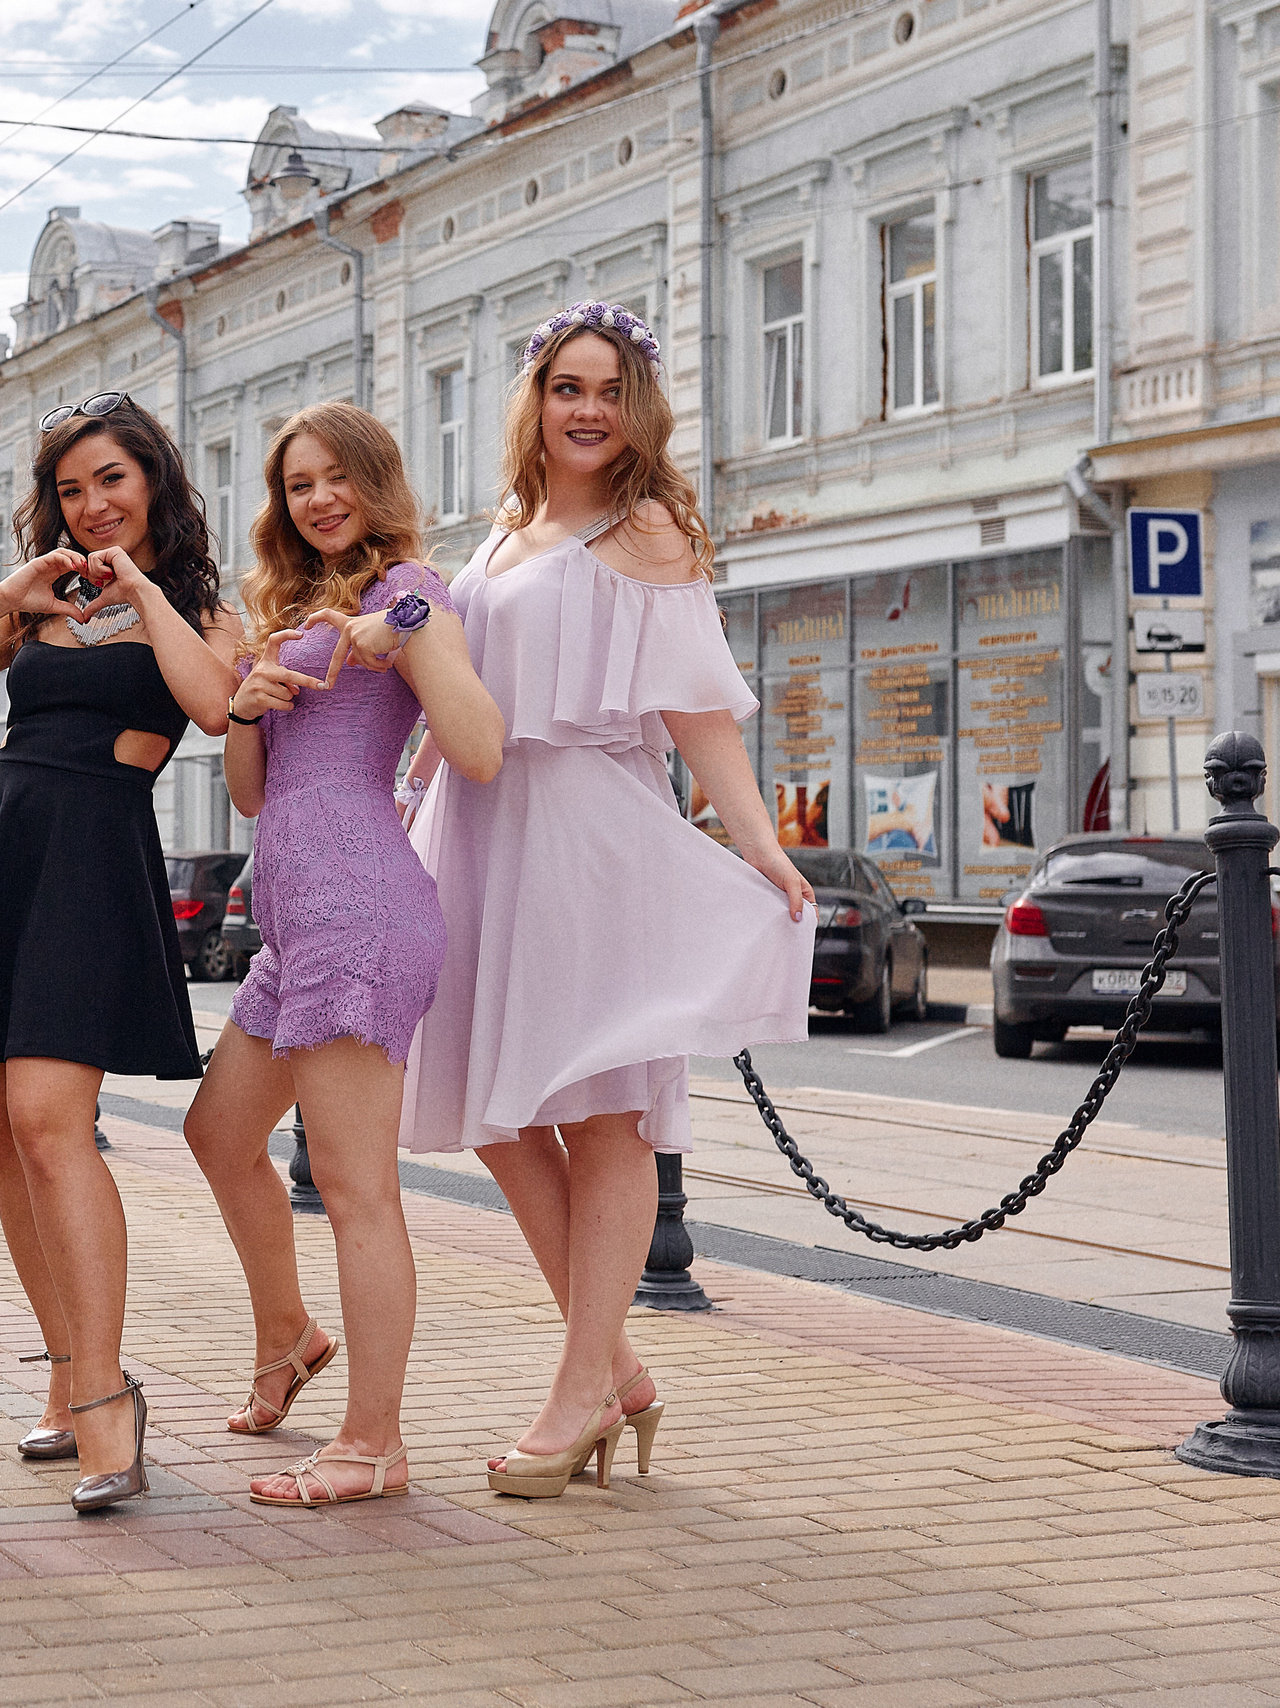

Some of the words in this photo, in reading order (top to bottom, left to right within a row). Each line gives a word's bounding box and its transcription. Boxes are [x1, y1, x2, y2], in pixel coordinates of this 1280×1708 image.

[1148, 518, 1189, 589] P
[1162, 687, 1175, 703] 15
[1180, 686, 1198, 705] 20
